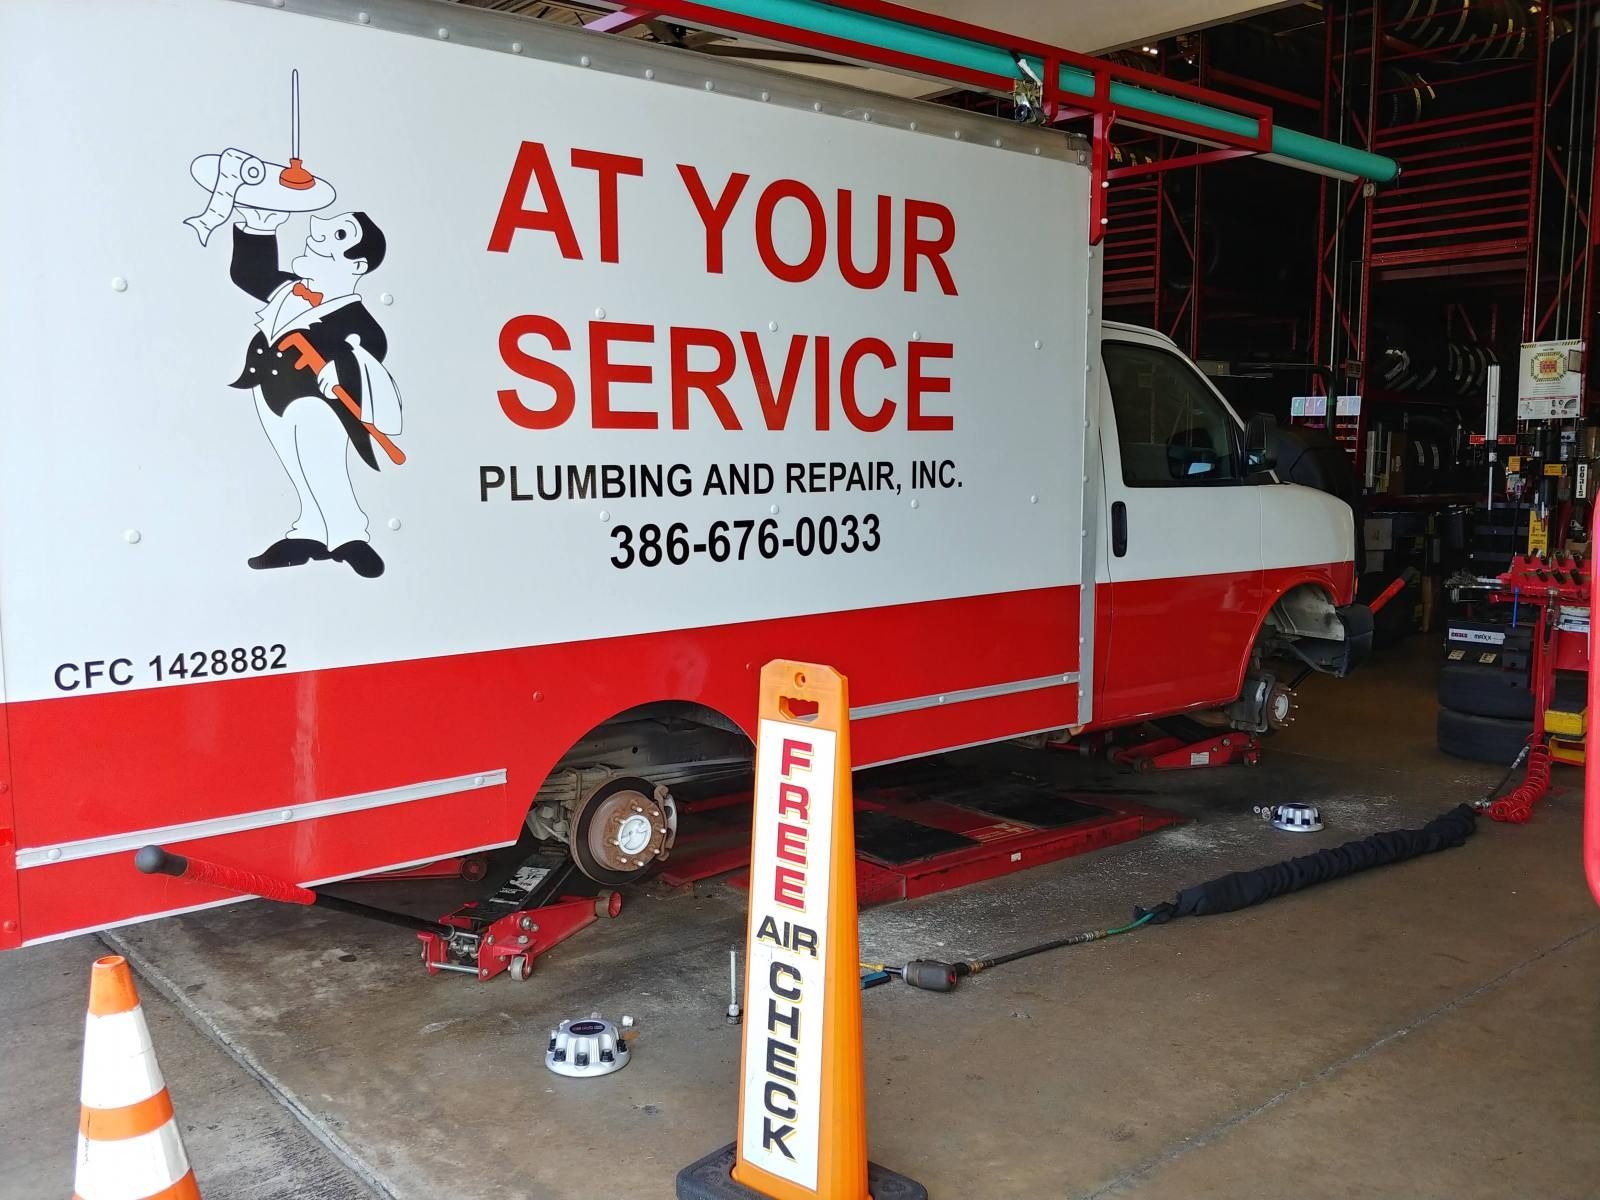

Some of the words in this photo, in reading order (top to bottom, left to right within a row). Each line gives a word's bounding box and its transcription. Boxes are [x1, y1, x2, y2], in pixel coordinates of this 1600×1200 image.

[487, 141, 643, 264] AT
[678, 164, 959, 297] YOUR
[497, 314, 954, 432] SERVICE
[479, 463, 693, 502] PLUMBING
[702, 463, 775, 497] AND
[786, 461, 902, 496] REPAIR,
[911, 459, 963, 490] INC.
[610, 513, 881, 570] 386-676-0033
[54, 658, 135, 691] CFC
[149, 643, 287, 682] 1428882
[774, 739, 814, 911] FREE
[757, 915, 819, 957] AIR
[763, 961, 803, 1161] CHECK
